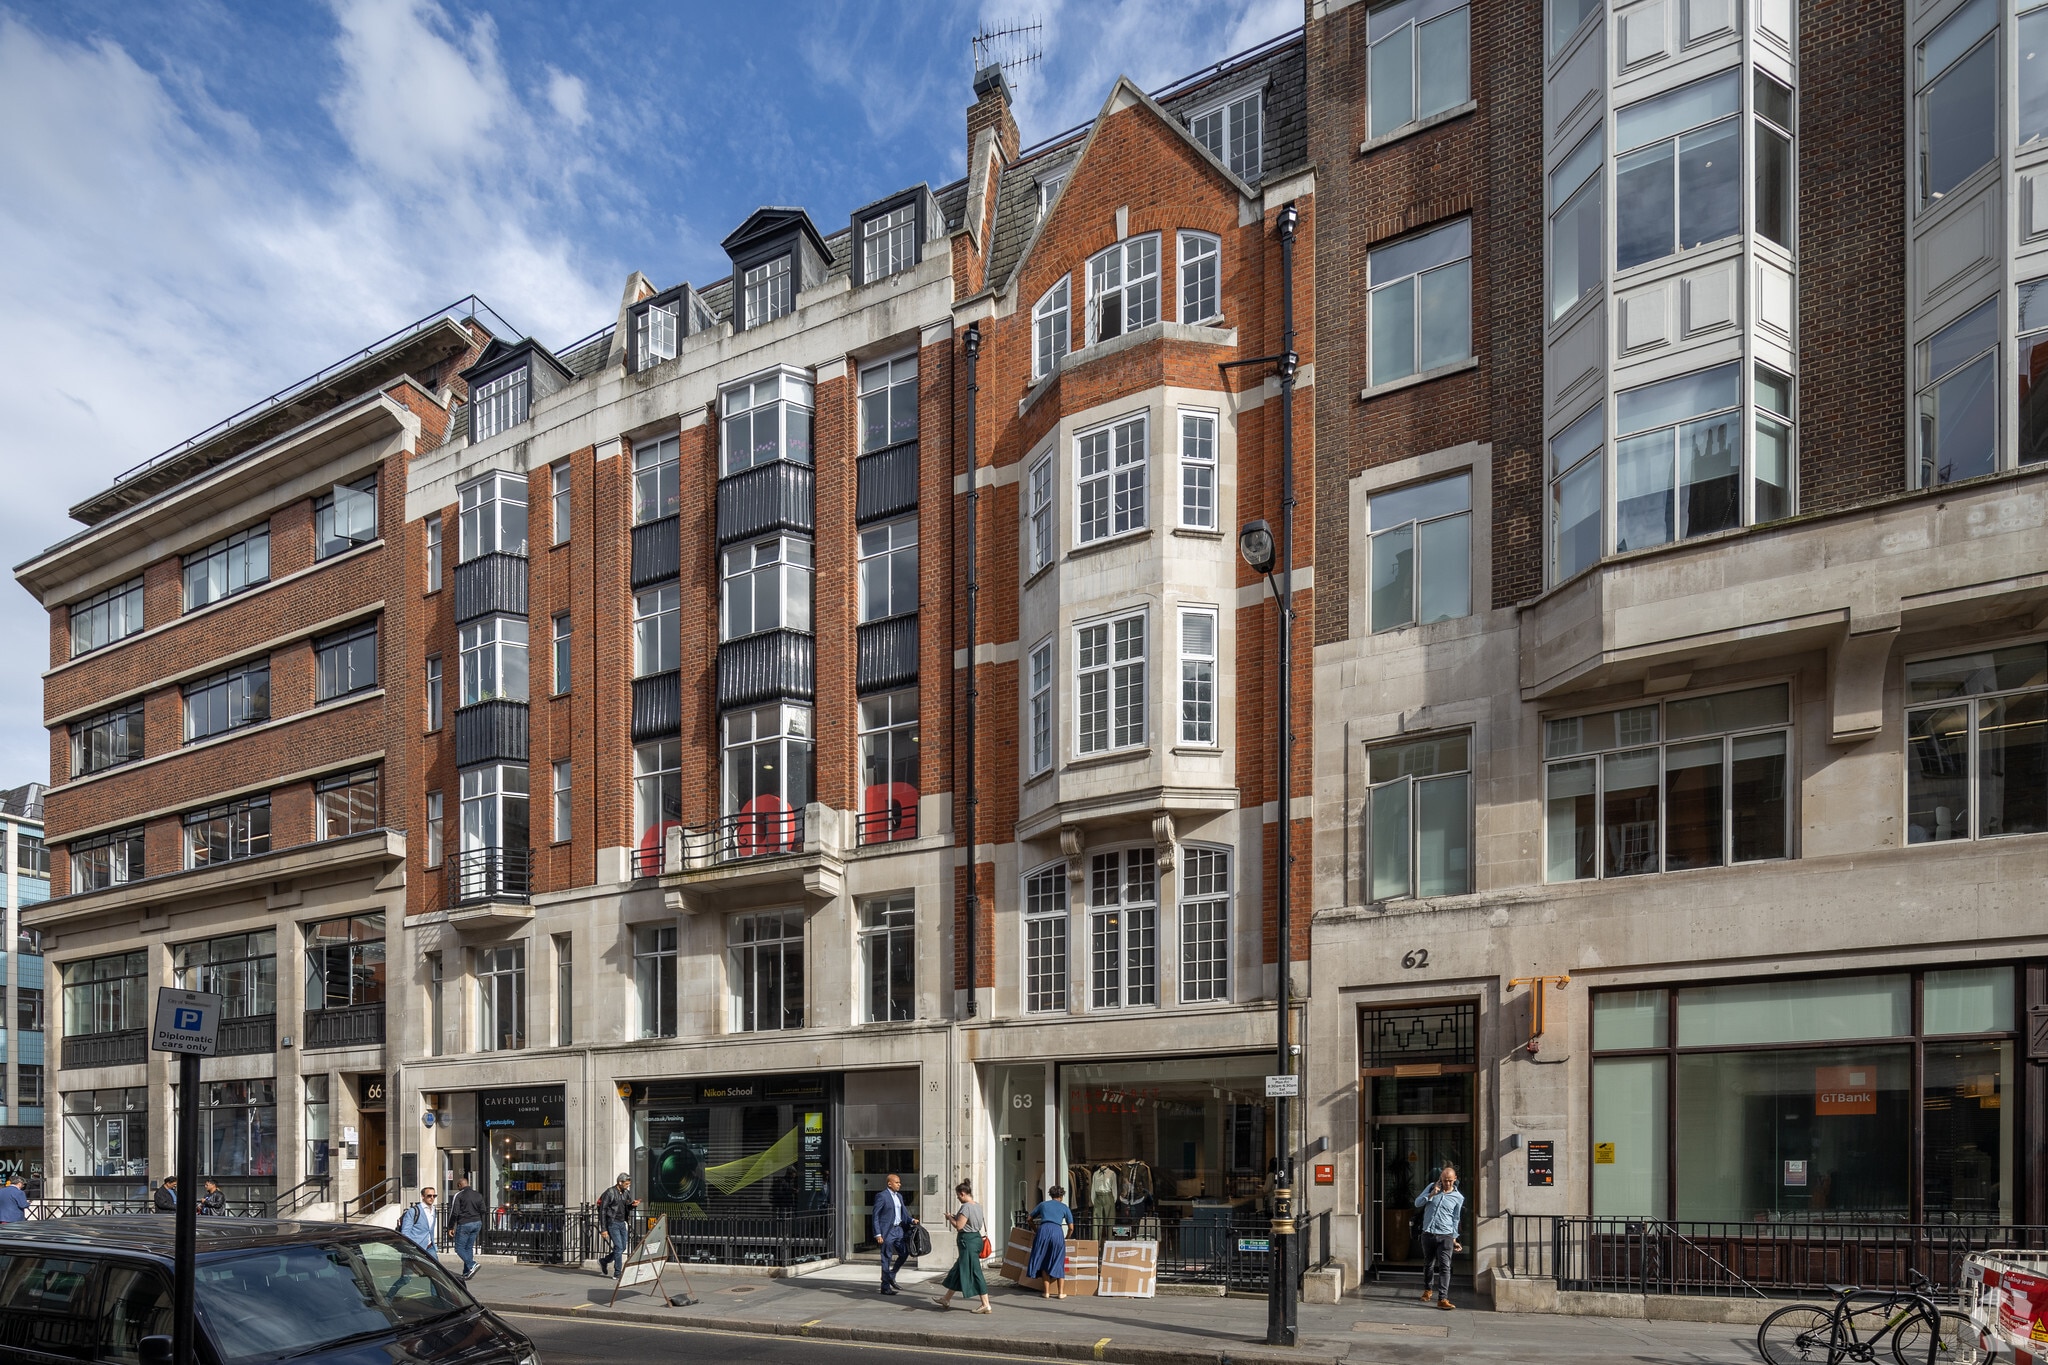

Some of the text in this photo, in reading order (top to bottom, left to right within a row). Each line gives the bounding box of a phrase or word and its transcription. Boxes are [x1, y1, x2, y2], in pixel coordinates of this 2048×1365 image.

[1401, 948, 1429, 969] 62
[180, 1010, 199, 1028] P
[159, 1031, 213, 1044] Diplomatic
[161, 1041, 208, 1053] cars only
[703, 1086, 753, 1097] Nikon School
[484, 1096, 537, 1106] CAVENDISH
[1012, 1094, 1033, 1109] 63
[1821, 1093, 1871, 1103] GTBank
[1071, 1104, 1138, 1113] HOWELL
[805, 1135, 822, 1144] NPS
